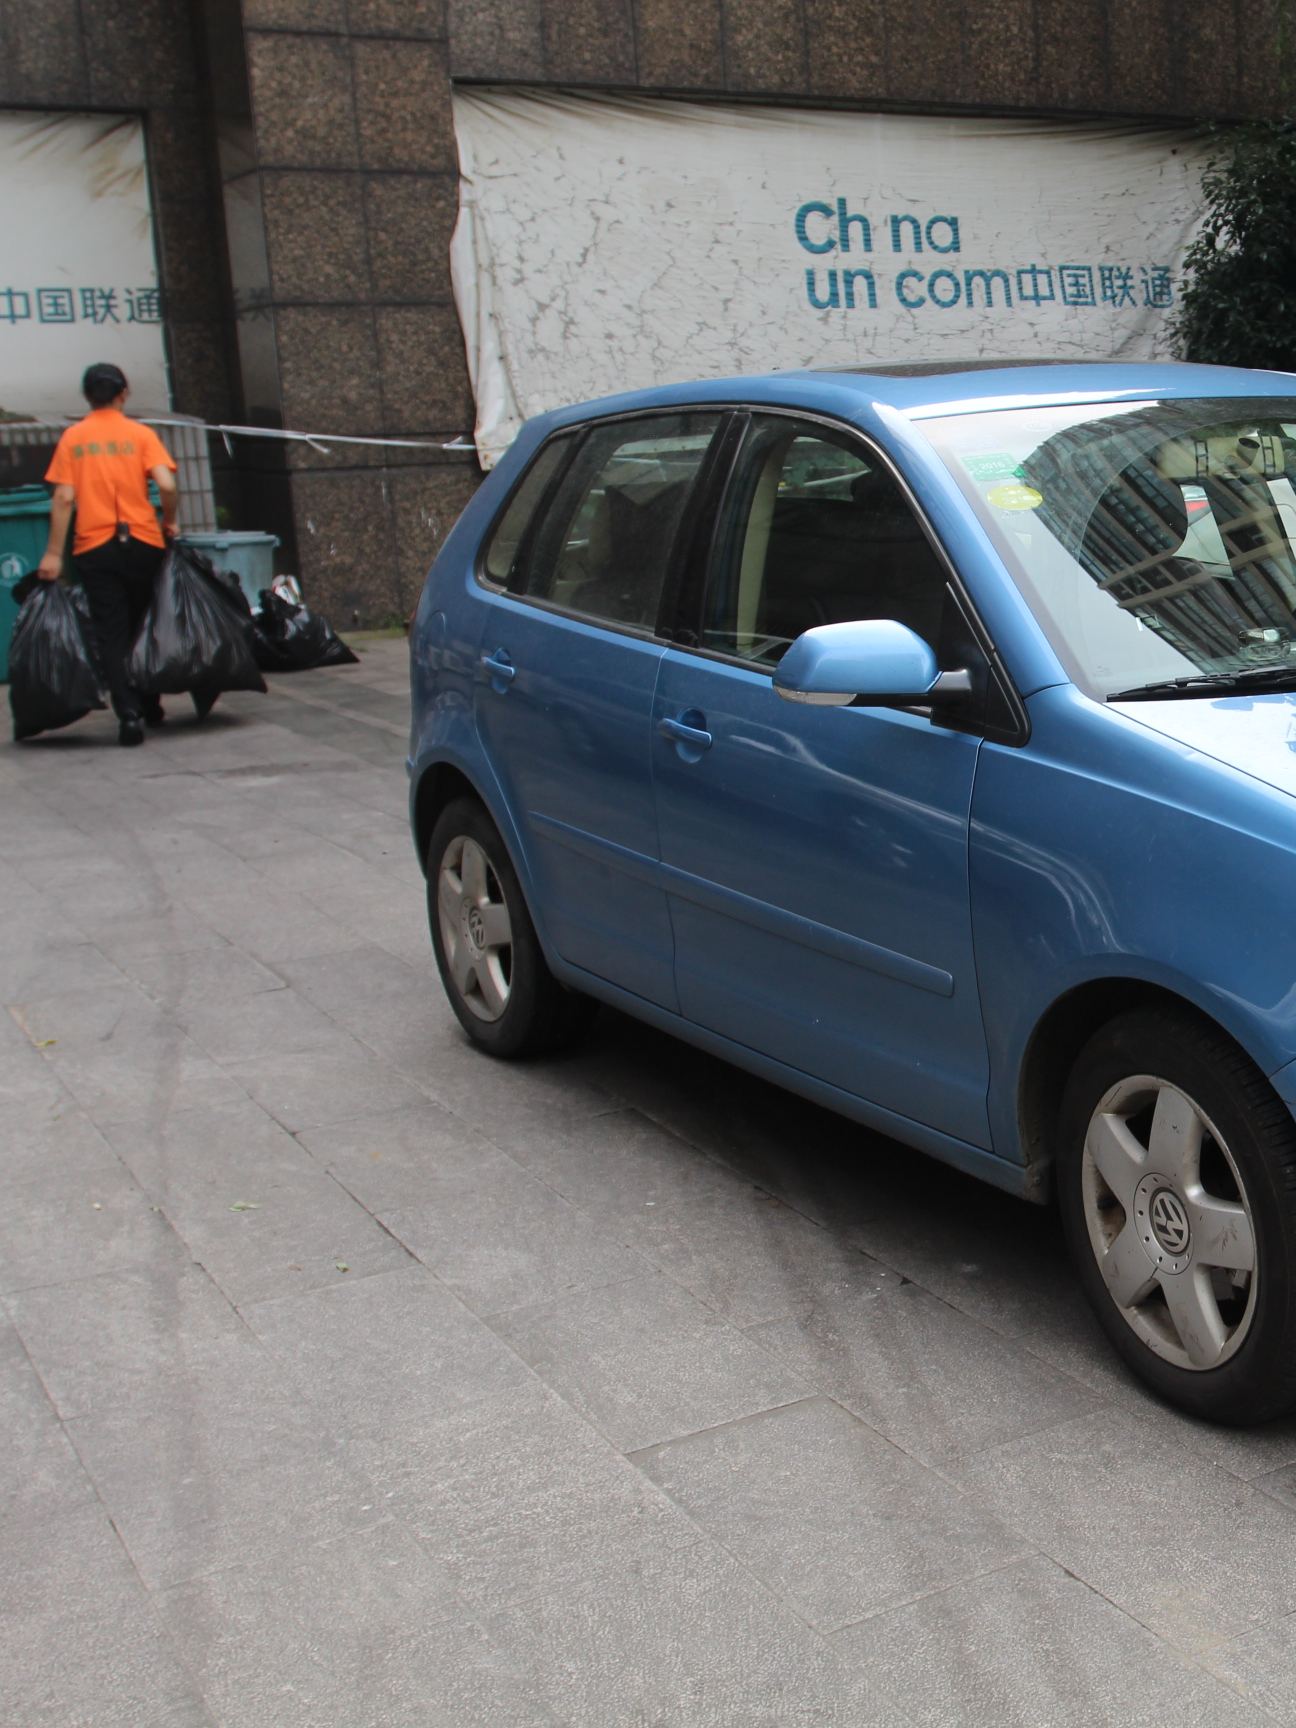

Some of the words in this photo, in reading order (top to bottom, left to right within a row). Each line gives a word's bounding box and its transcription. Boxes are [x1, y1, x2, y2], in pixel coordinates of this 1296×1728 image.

[795, 197, 961, 254] Chna
[0, 287, 162, 324] 中国联通
[1016, 264, 1174, 309] 中国联通
